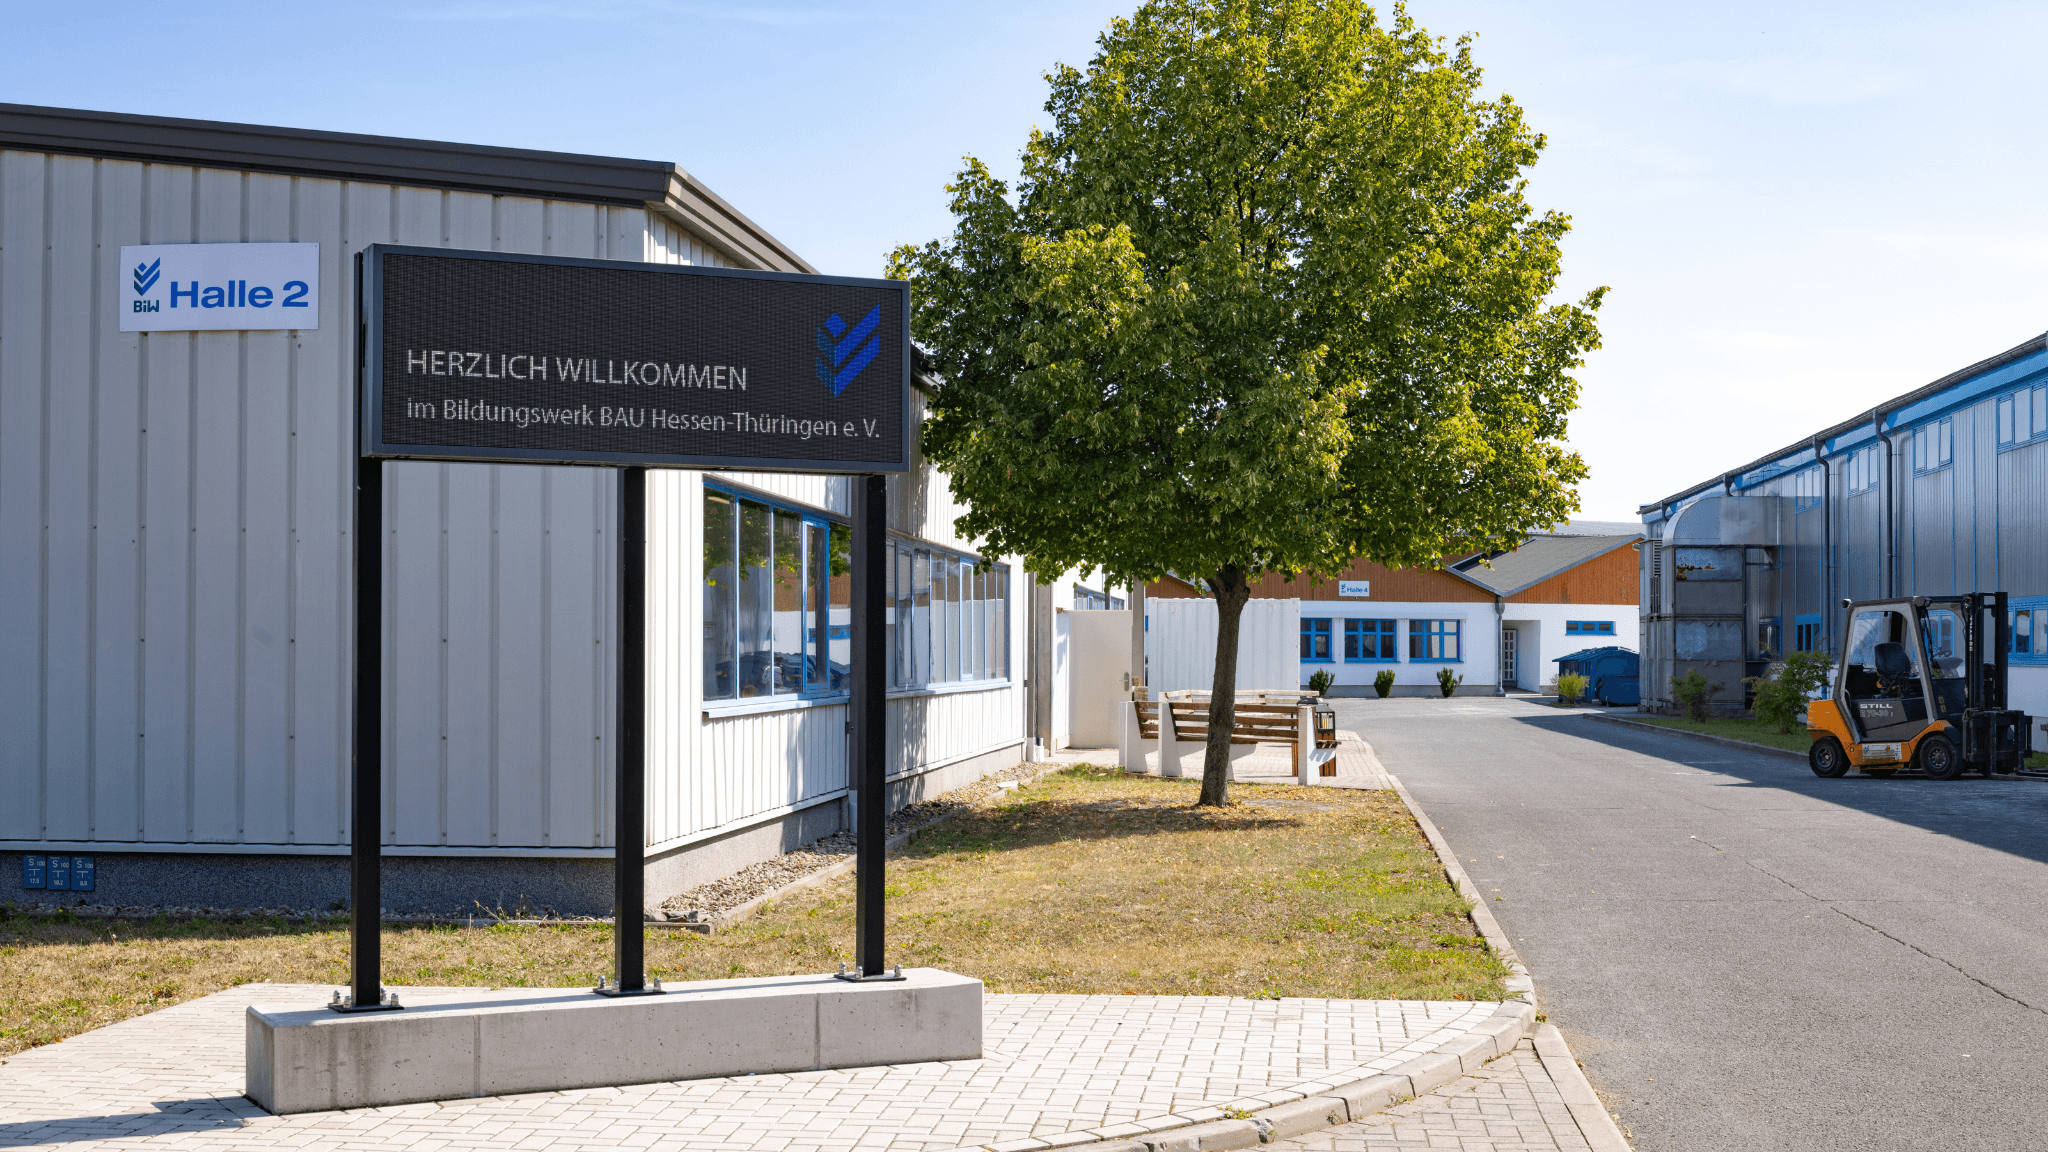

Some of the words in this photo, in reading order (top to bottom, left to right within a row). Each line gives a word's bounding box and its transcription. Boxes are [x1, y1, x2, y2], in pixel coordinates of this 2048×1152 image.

[170, 280, 273, 308] Halle
[282, 280, 309, 308] 2
[407, 349, 547, 381] HERZLICH
[556, 357, 747, 391] WILLKOMMEN
[407, 398, 436, 419] im
[443, 399, 594, 428] Bildungswerk
[600, 407, 645, 428] BAU
[652, 411, 837, 440] Hessen-Thüringen
[844, 423, 859, 437] e.
[862, 419, 880, 438] V.
[28, 858, 34, 867] S
[52, 860, 59, 868] S
[76, 860, 83, 869] S
